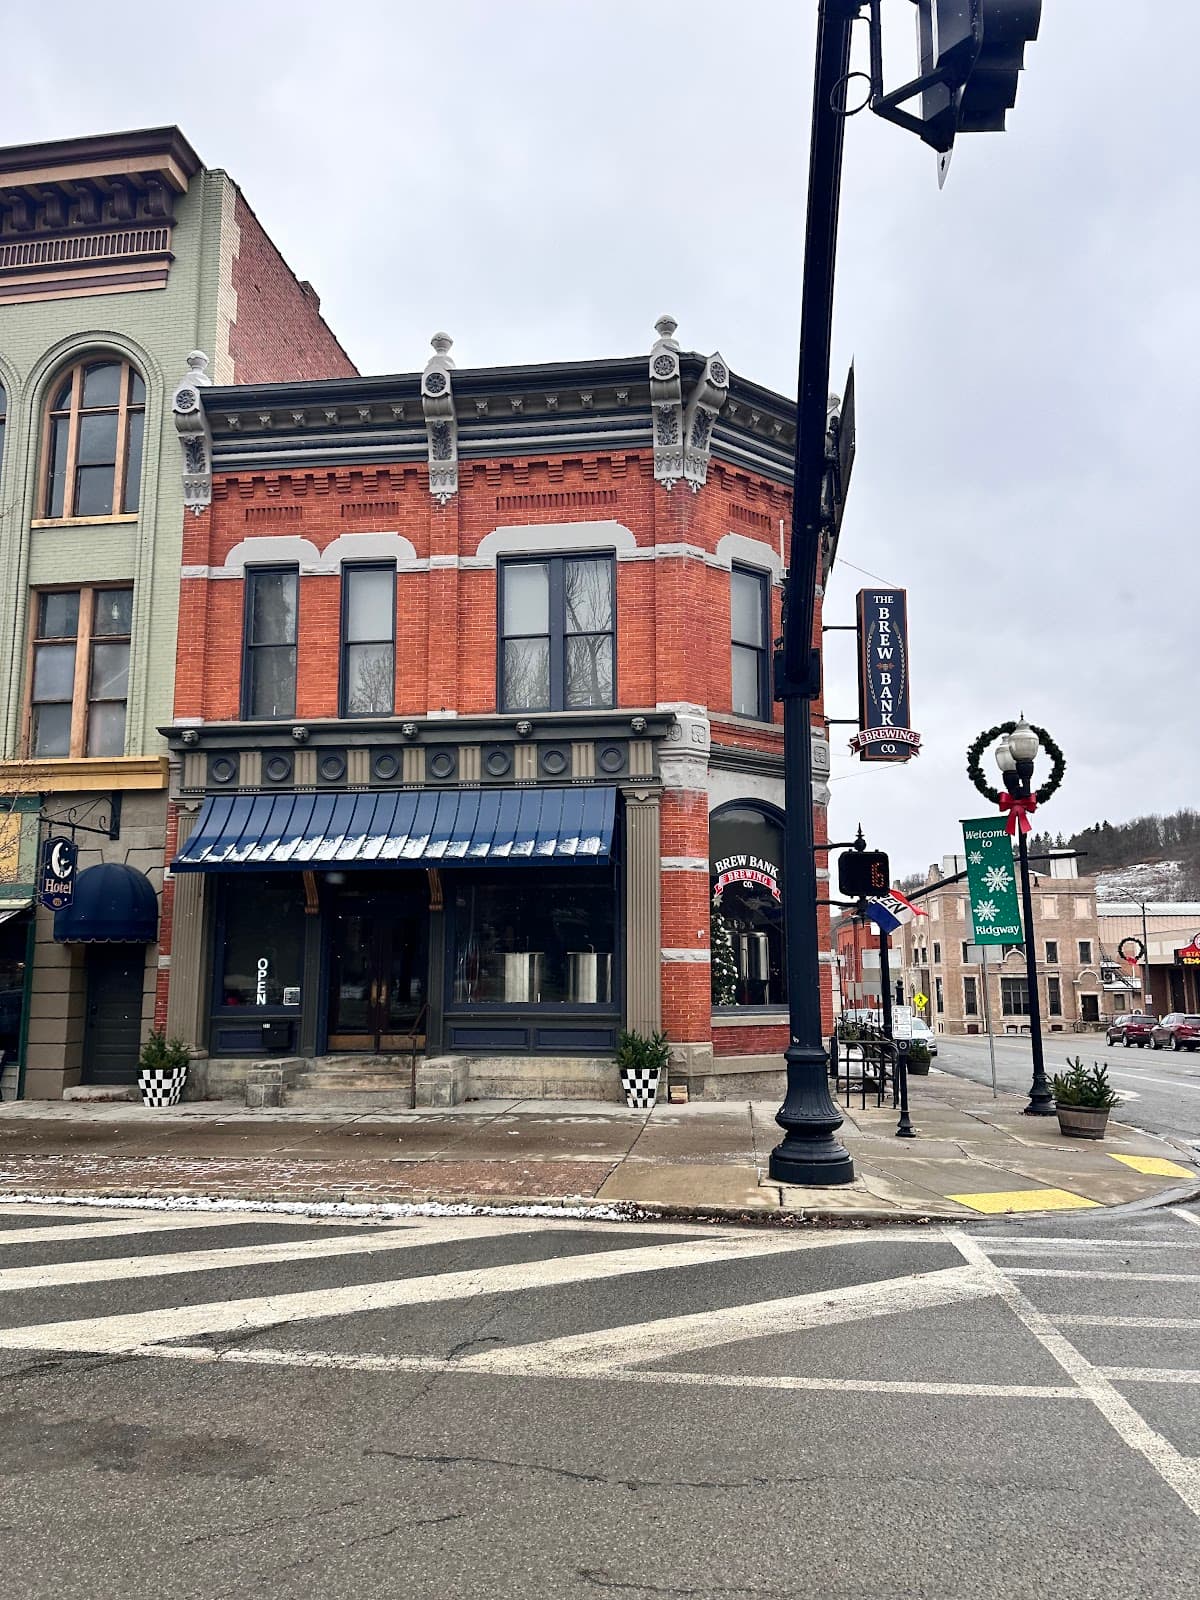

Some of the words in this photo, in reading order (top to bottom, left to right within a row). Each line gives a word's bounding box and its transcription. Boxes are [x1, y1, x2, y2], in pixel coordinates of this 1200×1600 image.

[873, 595, 894, 604] THE
[877, 607, 894, 660] BREW
[880, 672, 894, 726] BANK
[864, 731, 915, 742] BREWING
[880, 744, 897, 753] CO.
[965, 829, 1009, 840] Welcome
[981, 839, 993, 848] to
[715, 855, 747, 873] BREW
[749, 856, 779, 878] BANK
[727, 870, 768, 884] BREWING
[44, 878, 72, 895] Hotel
[743, 881, 754, 889] CO.
[975, 925, 1020, 937] Ridgway
[256, 958, 268, 1006] OPEN
